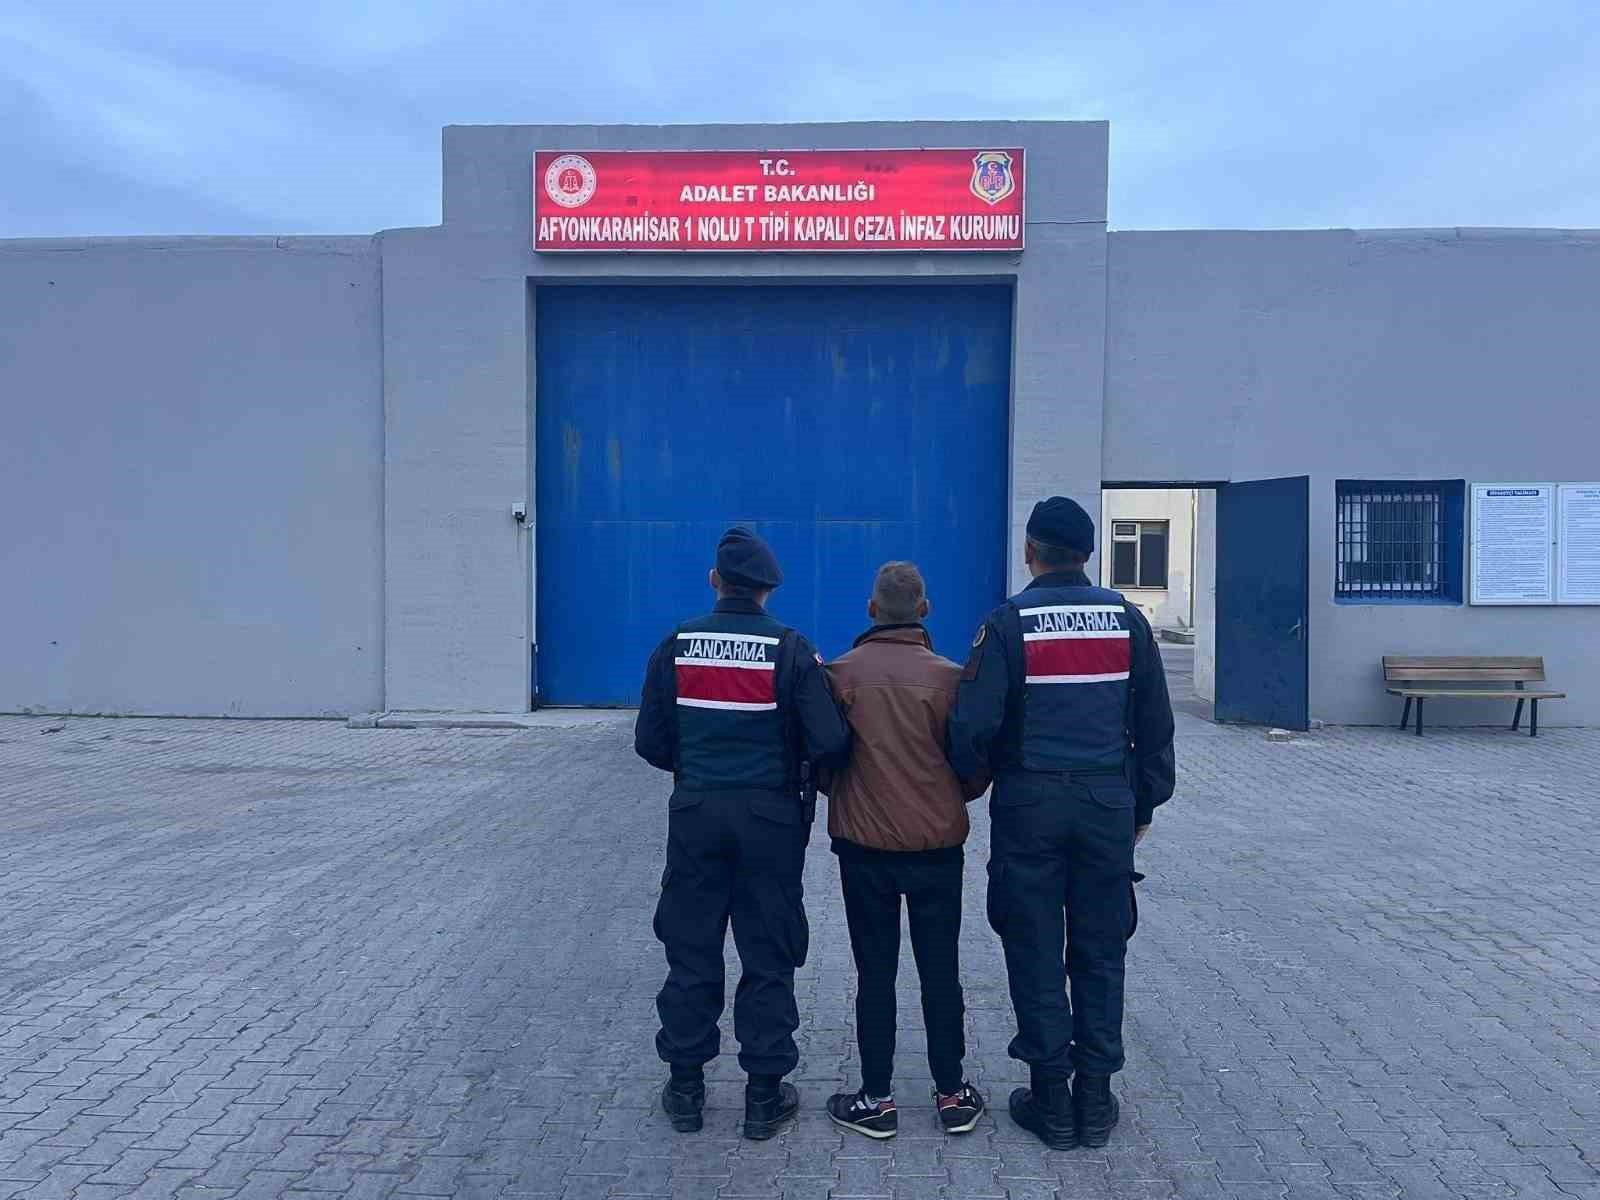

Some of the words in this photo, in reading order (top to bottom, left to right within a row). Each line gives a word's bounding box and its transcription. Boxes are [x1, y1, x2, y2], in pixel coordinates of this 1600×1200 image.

[759, 159, 795, 176] T.C.
[680, 185, 757, 202] ADALET
[764, 180, 875, 202] BAKANLIĞI
[539, 210, 680, 241] AFYONKARAHİSAR
[684, 216, 692, 241] 1
[698, 216, 740, 241] NOLU
[744, 216, 755, 241] T
[759, 210, 789, 241] TİPİ
[794, 215, 849, 241] KAPALI
[854, 215, 896, 241] CEZA
[900, 209, 945, 241] İNFAZ
[950, 214, 1020, 241] KURUMU
[1033, 610, 1121, 633] JANDARMA
[683, 639, 767, 661] JANDARMA
